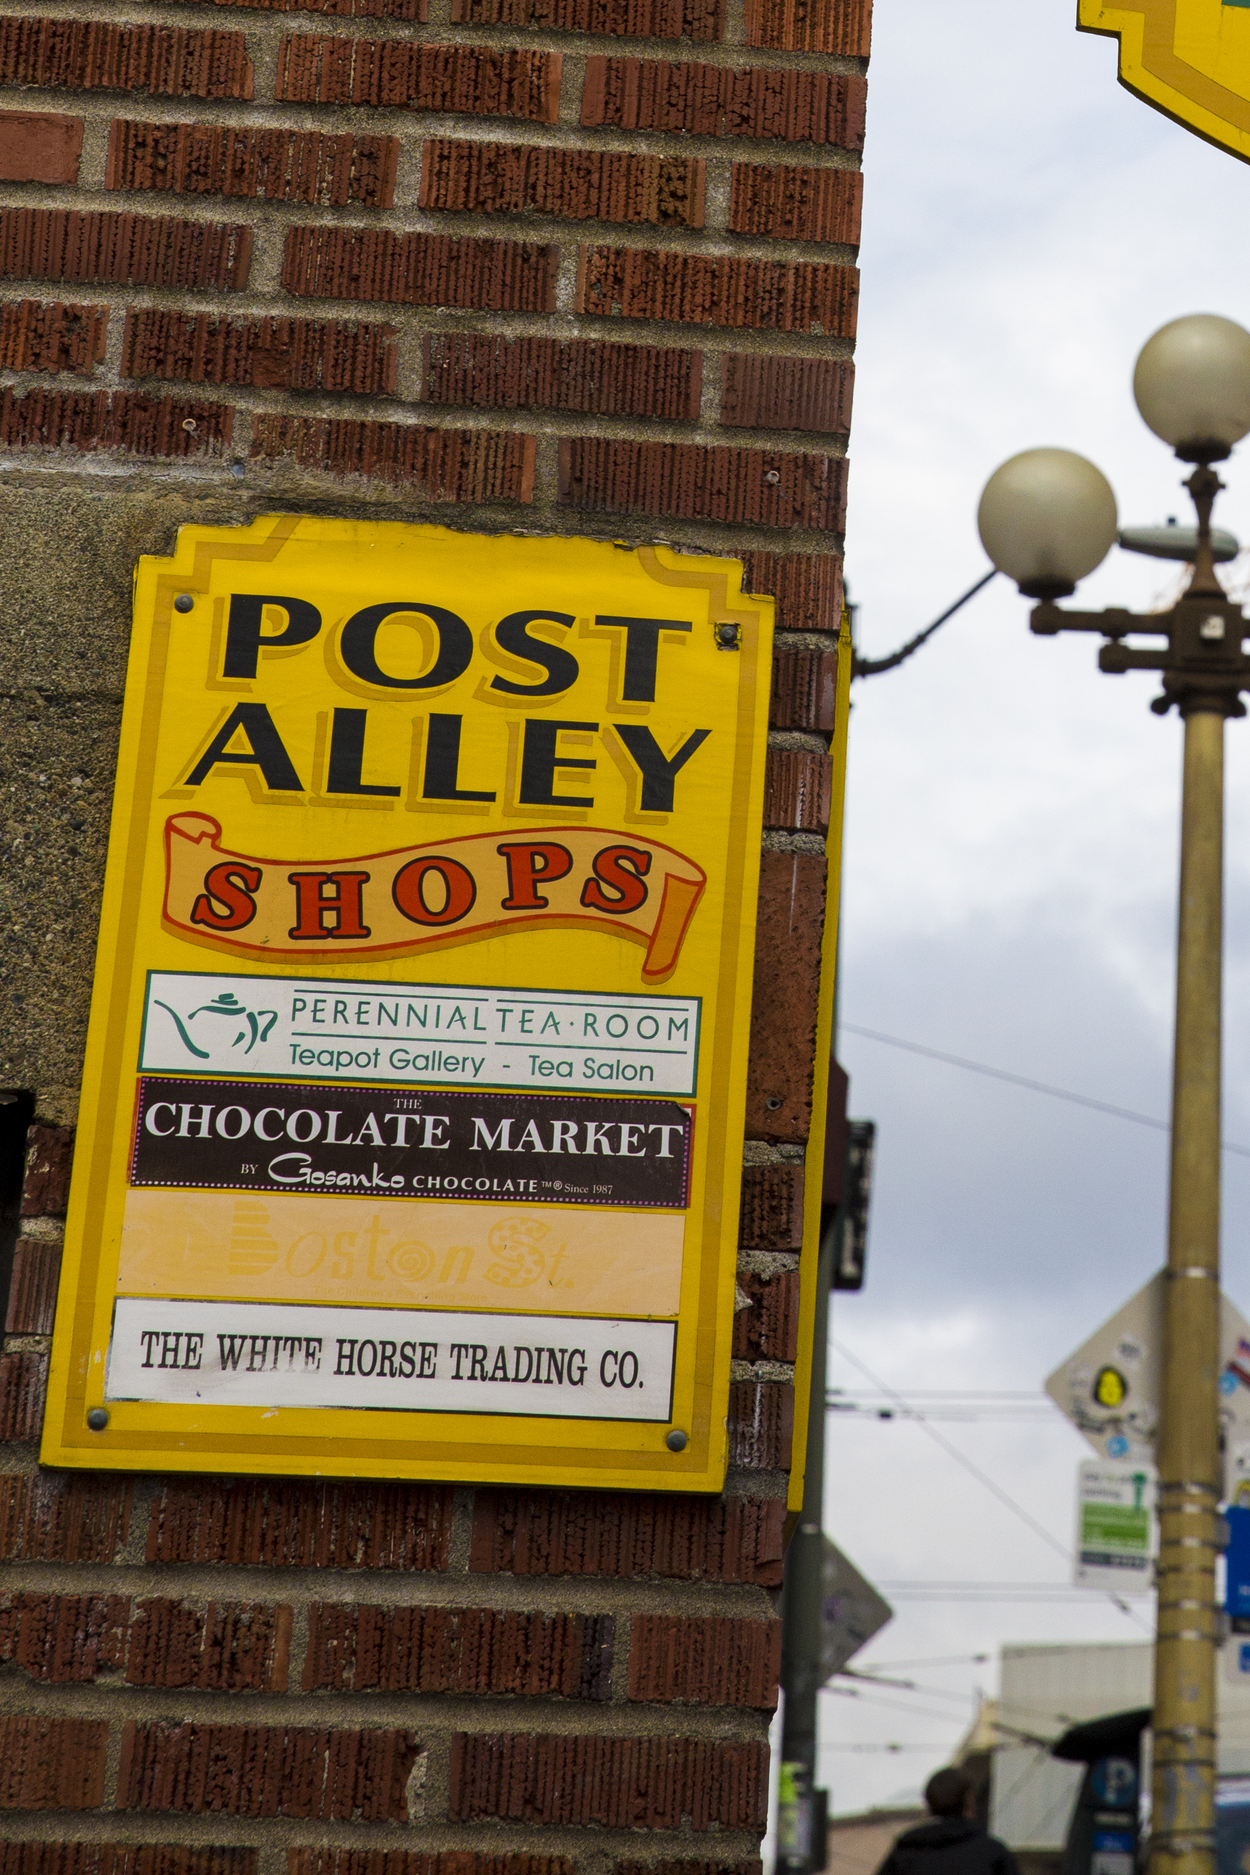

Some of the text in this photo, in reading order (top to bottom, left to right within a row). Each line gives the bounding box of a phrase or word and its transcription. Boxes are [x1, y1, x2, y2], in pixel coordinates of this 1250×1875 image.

[222, 593, 693, 704] POST
[184, 702, 713, 813] ALLEY
[190, 841, 653, 940] SHOPS
[291, 997, 488, 1031] PERENNIAL
[289, 1043, 381, 1072] Teapot
[389, 1048, 486, 1078] Gallery
[528, 1054, 574, 1078] Tea
[582, 1057, 655, 1082] Salon
[144, 1101, 684, 1158] CHOCOLATE MARKET
[393, 1097, 423, 1110] THE
[240, 1163, 259, 1174] BY
[267, 1151, 405, 1189] Gosanko
[412, 1175, 538, 1193] CHOCOLATE
[564, 1183, 589, 1194] Since
[592, 1184, 614, 1195] 1987
[228, 1199, 576, 1290] Boston St.
[140, 1330, 644, 1389] THE WHITE HORSE TRADING CO.
